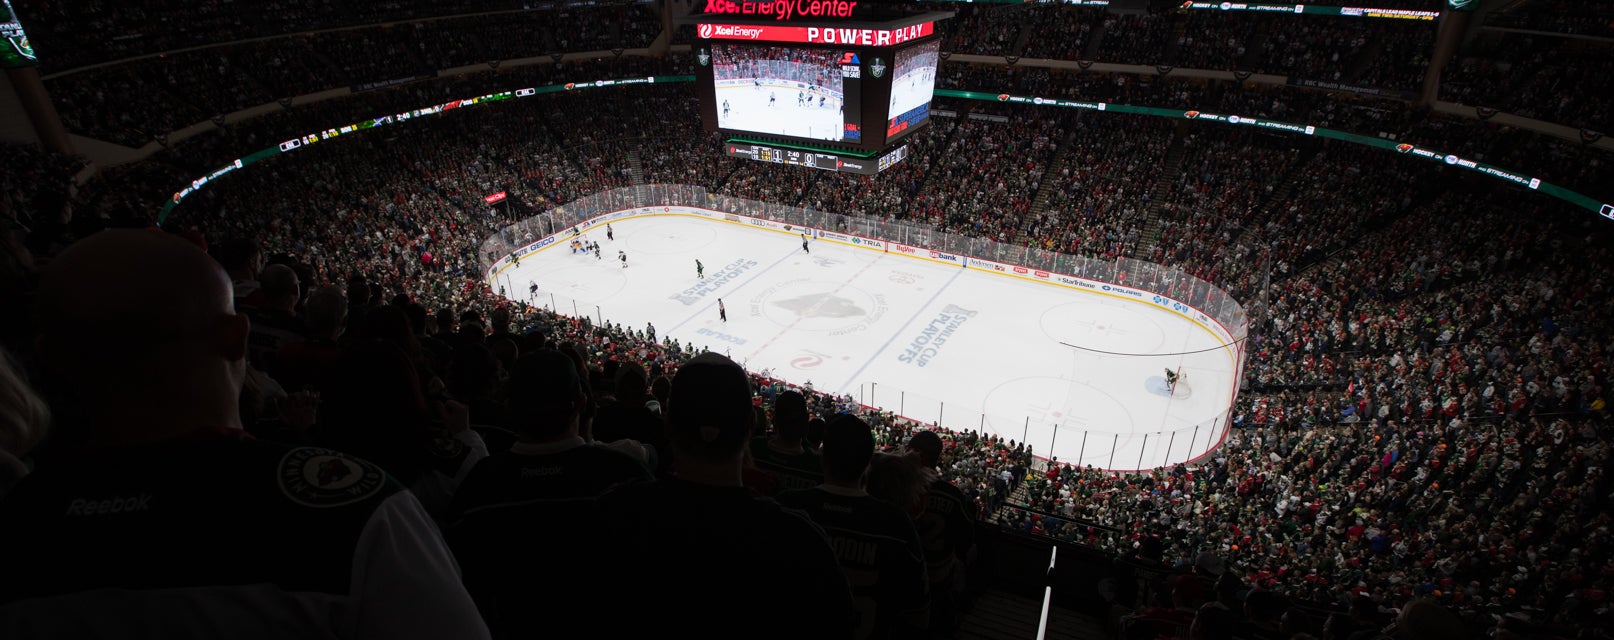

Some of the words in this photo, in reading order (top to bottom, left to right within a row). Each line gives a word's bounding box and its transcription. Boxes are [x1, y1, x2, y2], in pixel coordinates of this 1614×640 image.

[742, 0, 796, 20] Energy
[797, 0, 857, 17] Center
[808, 27, 890, 45] POWER
[896, 24, 923, 43] PLAY
[1412, 149, 1435, 158] HOCKEY
[1486, 168, 1523, 182] STREAMING
[530, 236, 554, 251] GEICO
[863, 237, 881, 247] TRIA
[682, 270, 725, 296] STANLEY
[725, 258, 744, 272] CUP
[696, 260, 758, 296] PLAYOFFS
[1112, 288, 1142, 297] POLARIS
[897, 313, 951, 364] PLAYOFFS
[932, 314, 967, 349] STANLEY
[916, 348, 937, 367] CUP
[66, 492, 152, 516] Reebok
